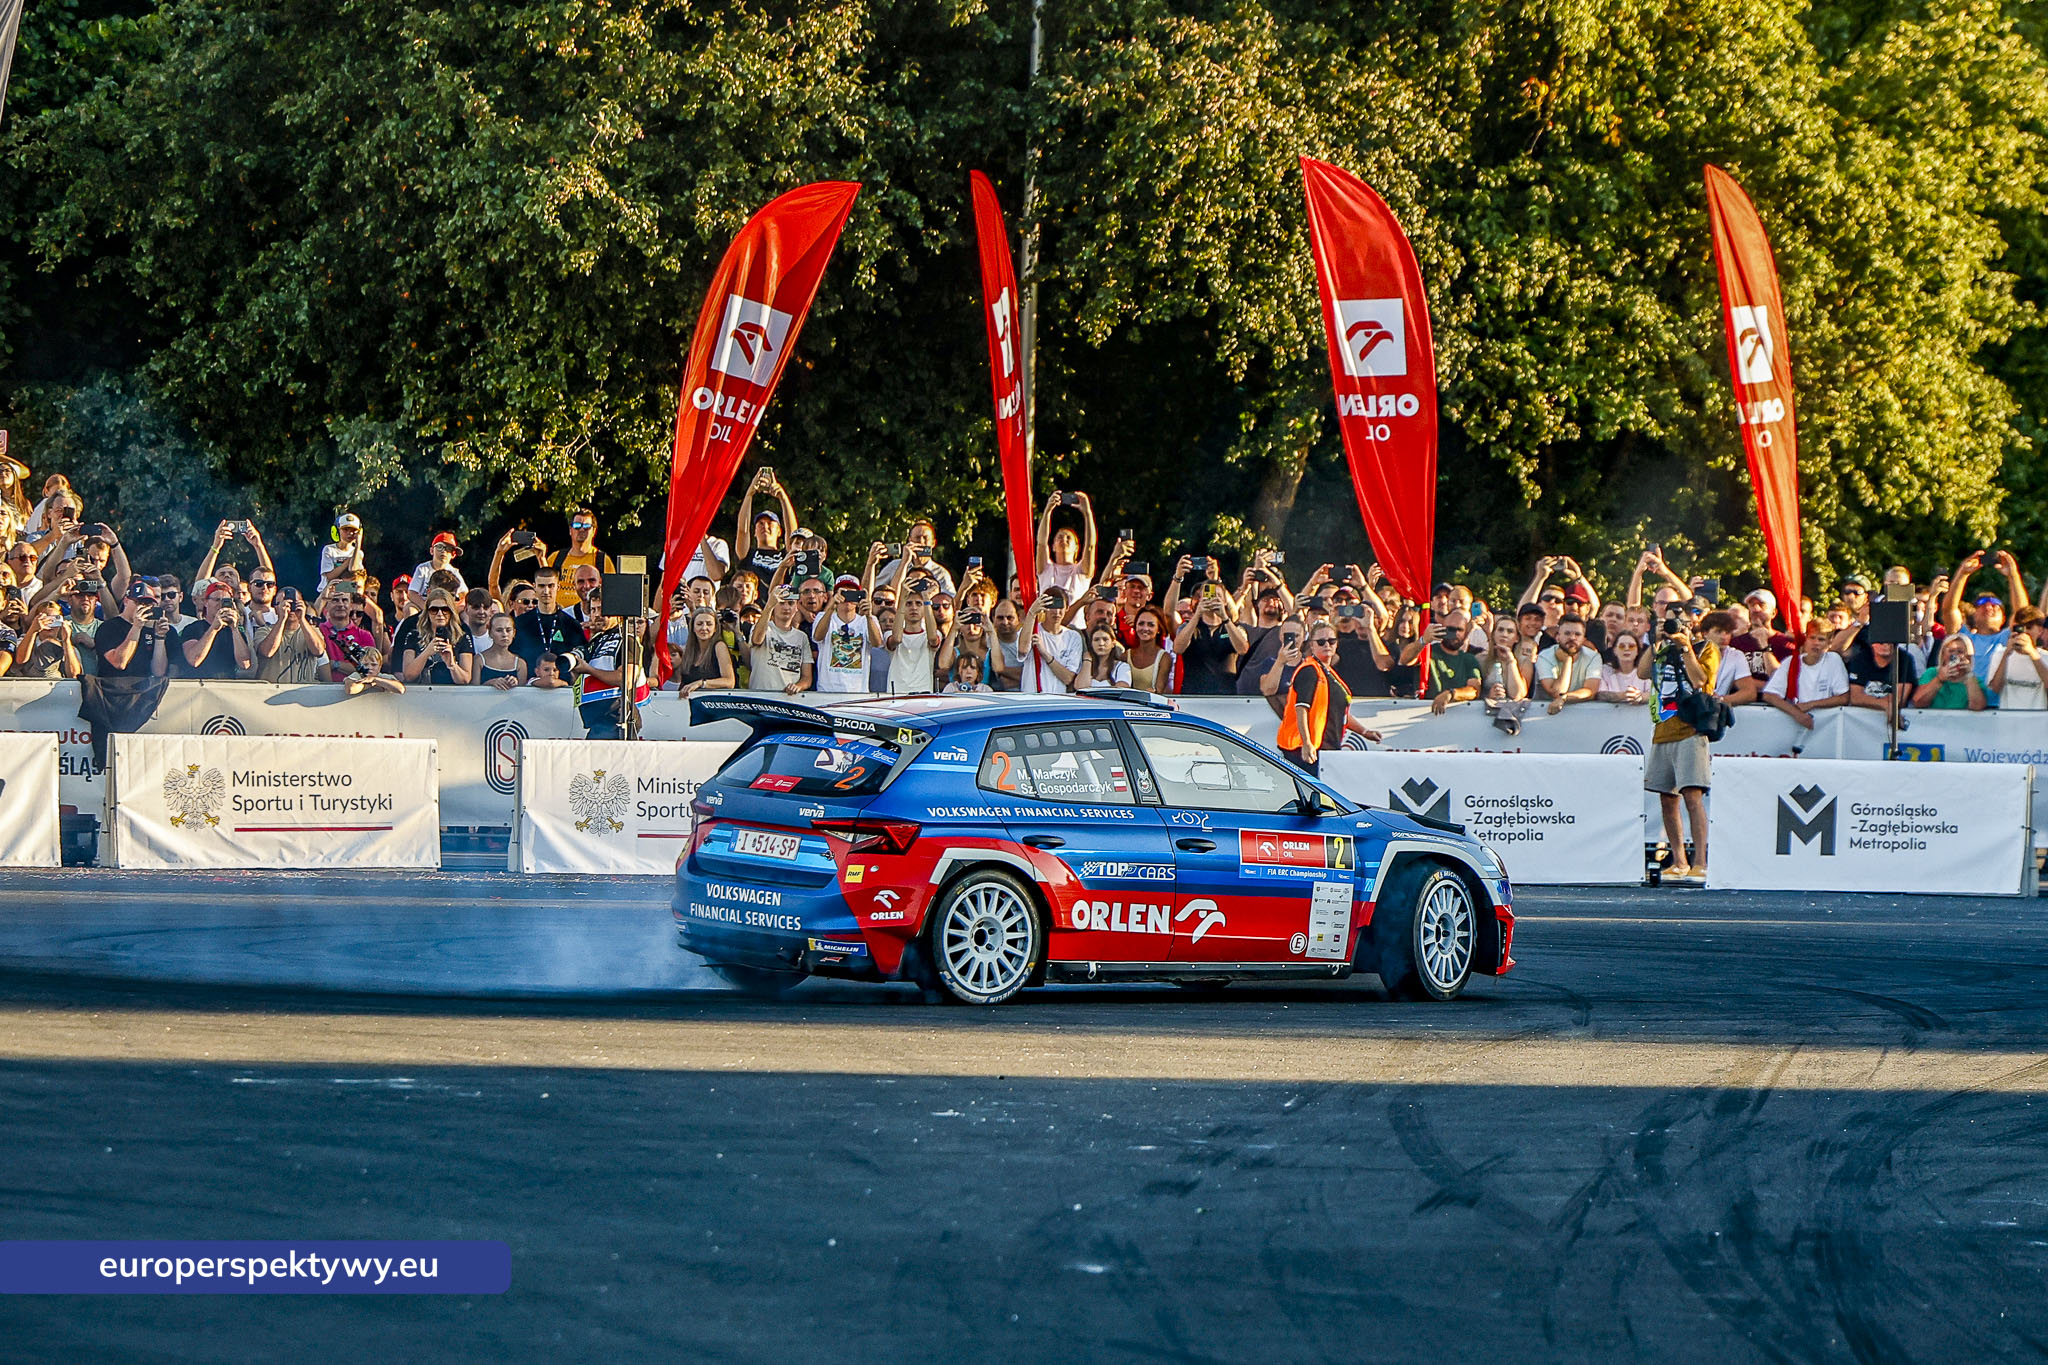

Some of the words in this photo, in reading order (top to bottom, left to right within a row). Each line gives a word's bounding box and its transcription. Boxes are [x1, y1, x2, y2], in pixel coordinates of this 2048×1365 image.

[701, 701, 751, 711] VOLKSWAGEN
[752, 703, 793, 716] FINANCIAL
[784, 735, 808, 743] FOLLOW
[933, 750, 968, 762] verva
[232, 770, 353, 787] Ministerstwo
[834, 766, 866, 789] 2
[991, 751, 1016, 791] 2
[1017, 768, 1031, 781] M.
[1033, 768, 1078, 781] Marczyk
[1021, 782, 1038, 795] Sz.
[1038, 781, 1112, 796] Gospodarczyk
[232, 794, 293, 814] Sportu
[299, 794, 304, 811] i
[309, 793, 393, 814] Turystyki
[1464, 794, 1554, 811] Górnośląsko
[799, 806, 825, 818] verva
[927, 807, 1012, 817] VOLKSWAGEN
[1015, 807, 1079, 818] FINANCIAL
[1079, 808, 1135, 819] SERVICES
[1851, 802, 1938, 820] Górnośląsko
[1474, 829, 1544, 844] etropolia
[1850, 836, 1928, 853] Metropolia
[1282, 841, 1310, 851] ORLEN
[1333, 837, 1346, 869] 2
[1137, 867, 1177, 880] CARS
[1267, 868, 1277, 876] FIA
[1289, 869, 1328, 879] Championship
[706, 883, 782, 907] VOLKSWAGEN
[690, 902, 743, 924] FINANCIAL
[745, 911, 801, 931] SERVICES
[870, 910, 904, 920] ORLEN
[1071, 899, 1171, 934] ORLEN
[823, 944, 860, 953] MICHELIN
